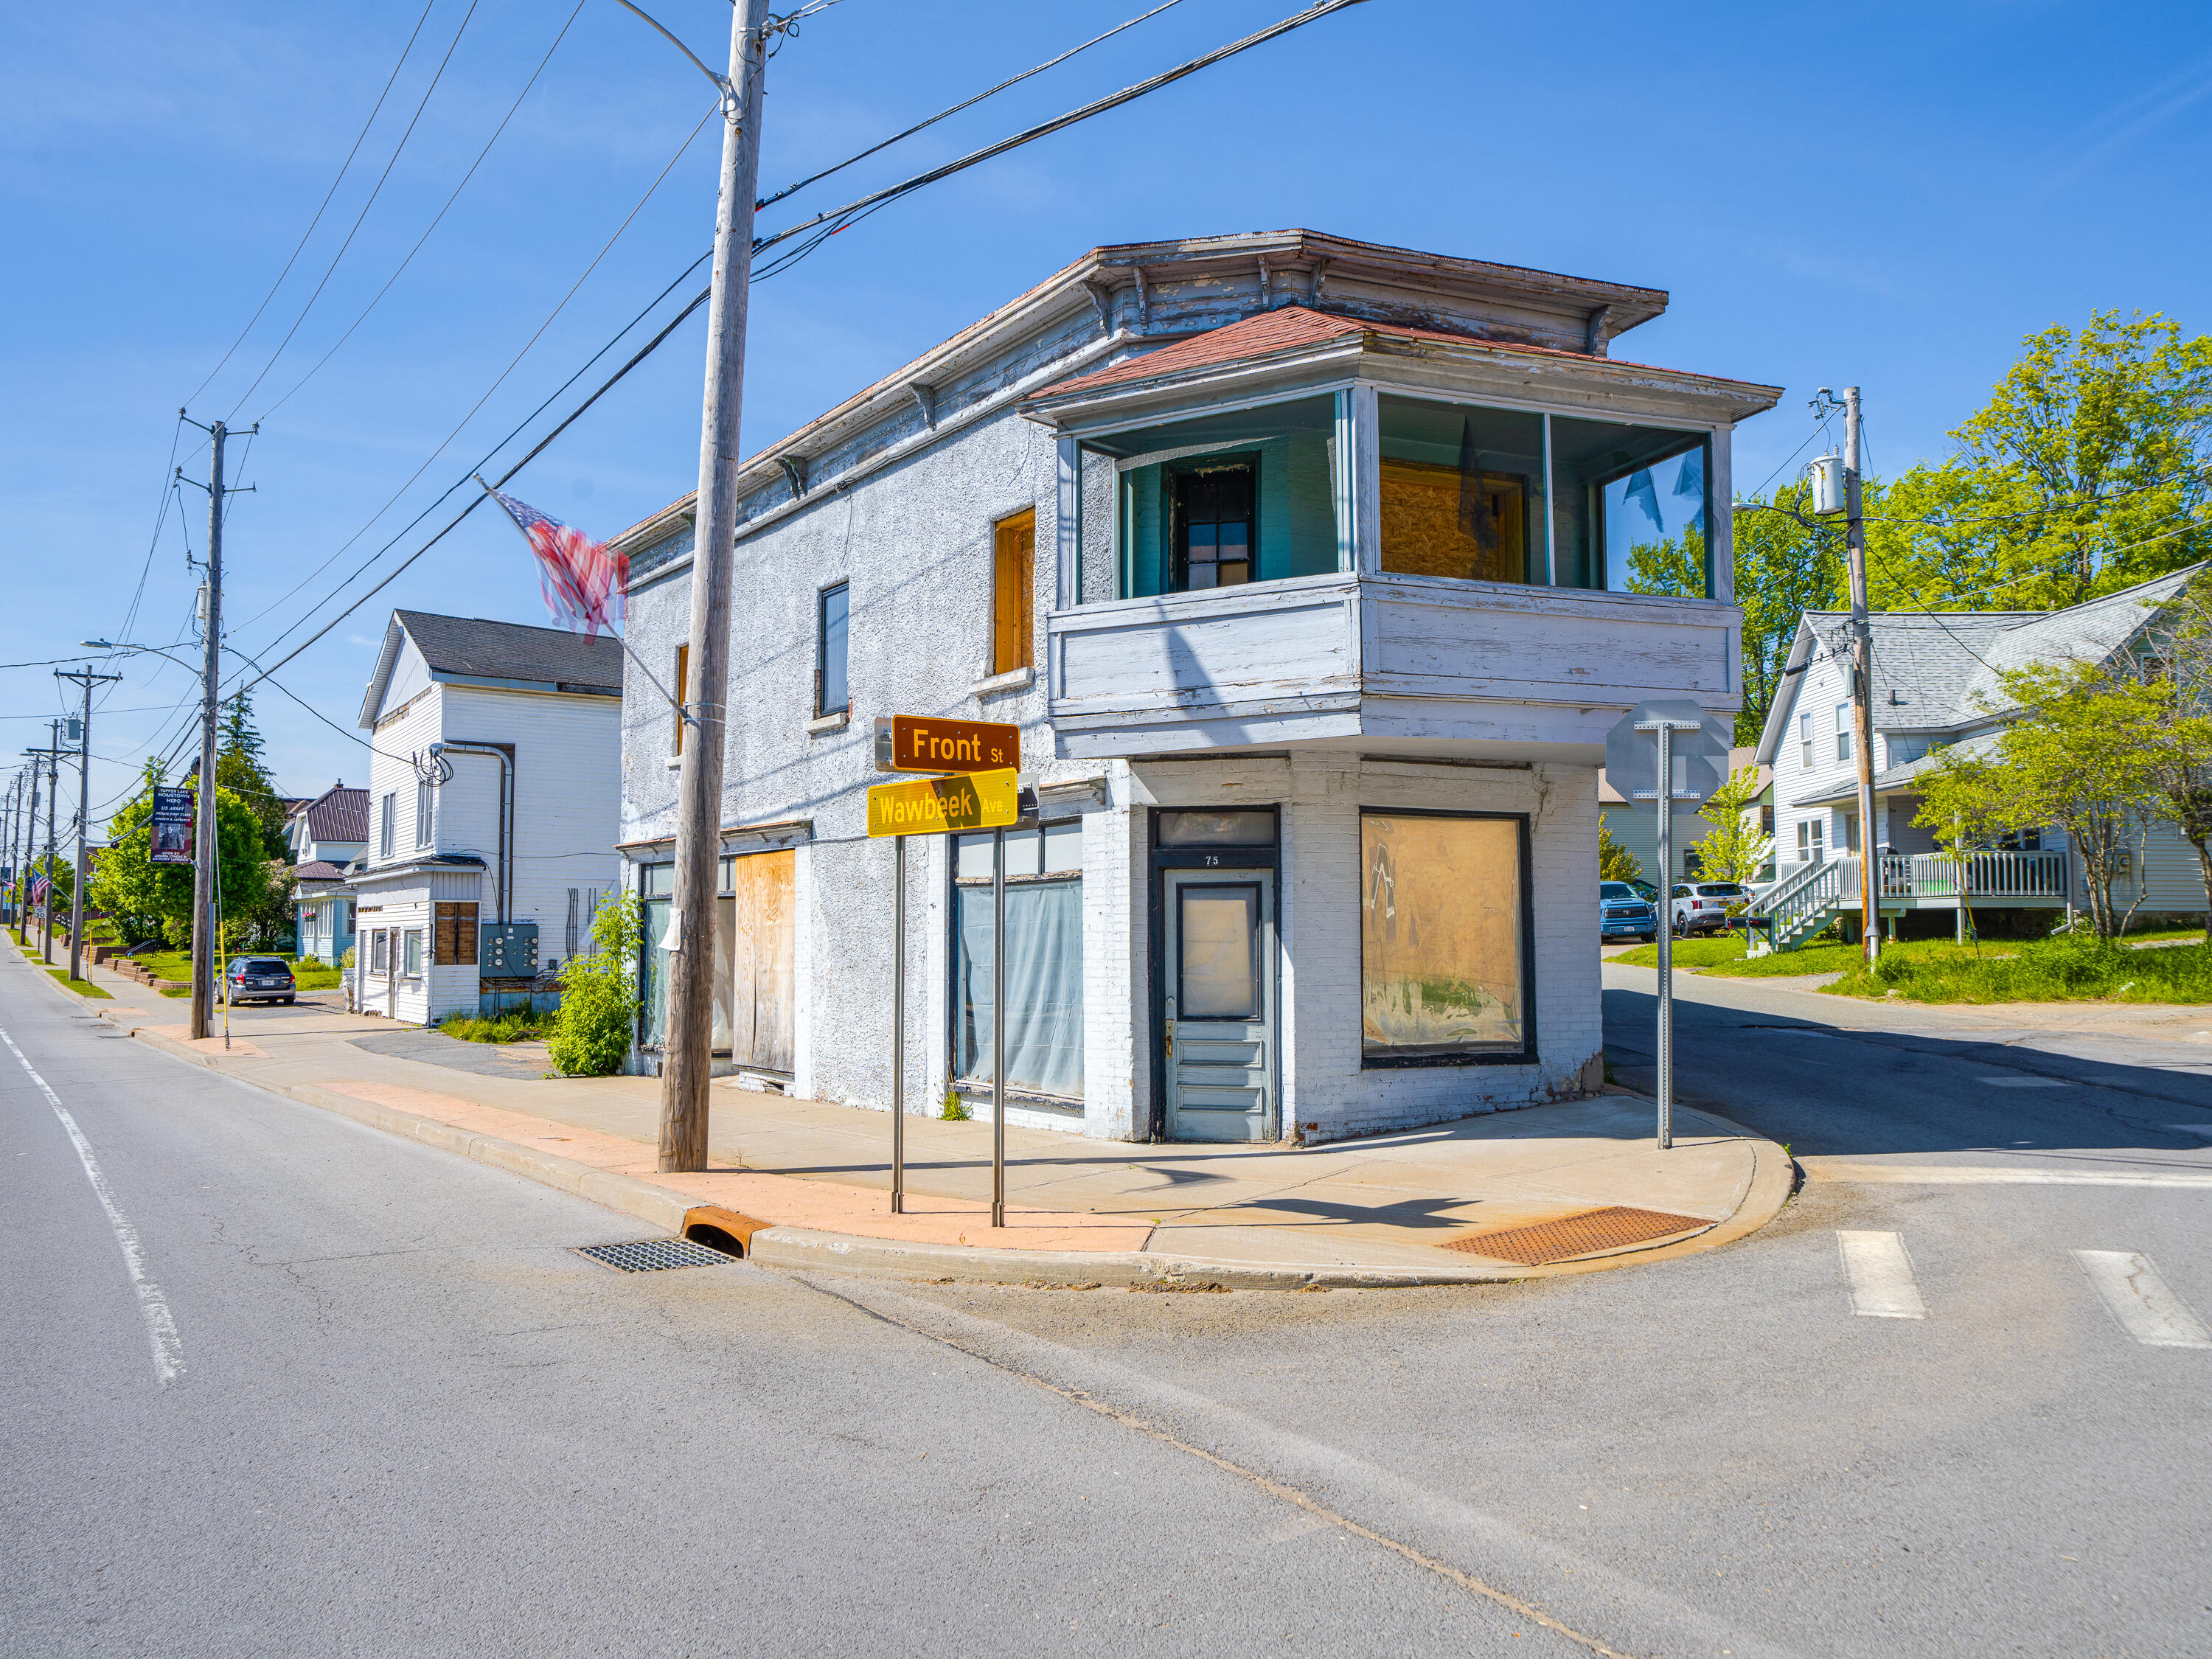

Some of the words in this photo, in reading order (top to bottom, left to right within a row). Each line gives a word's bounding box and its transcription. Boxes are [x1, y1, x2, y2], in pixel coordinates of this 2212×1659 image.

[914, 728, 981, 762] Front
[990, 748, 1004, 763] St
[880, 787, 973, 824] Wawbeek
[981, 799, 1004, 814] Ave
[1206, 856, 1219, 866] 75
